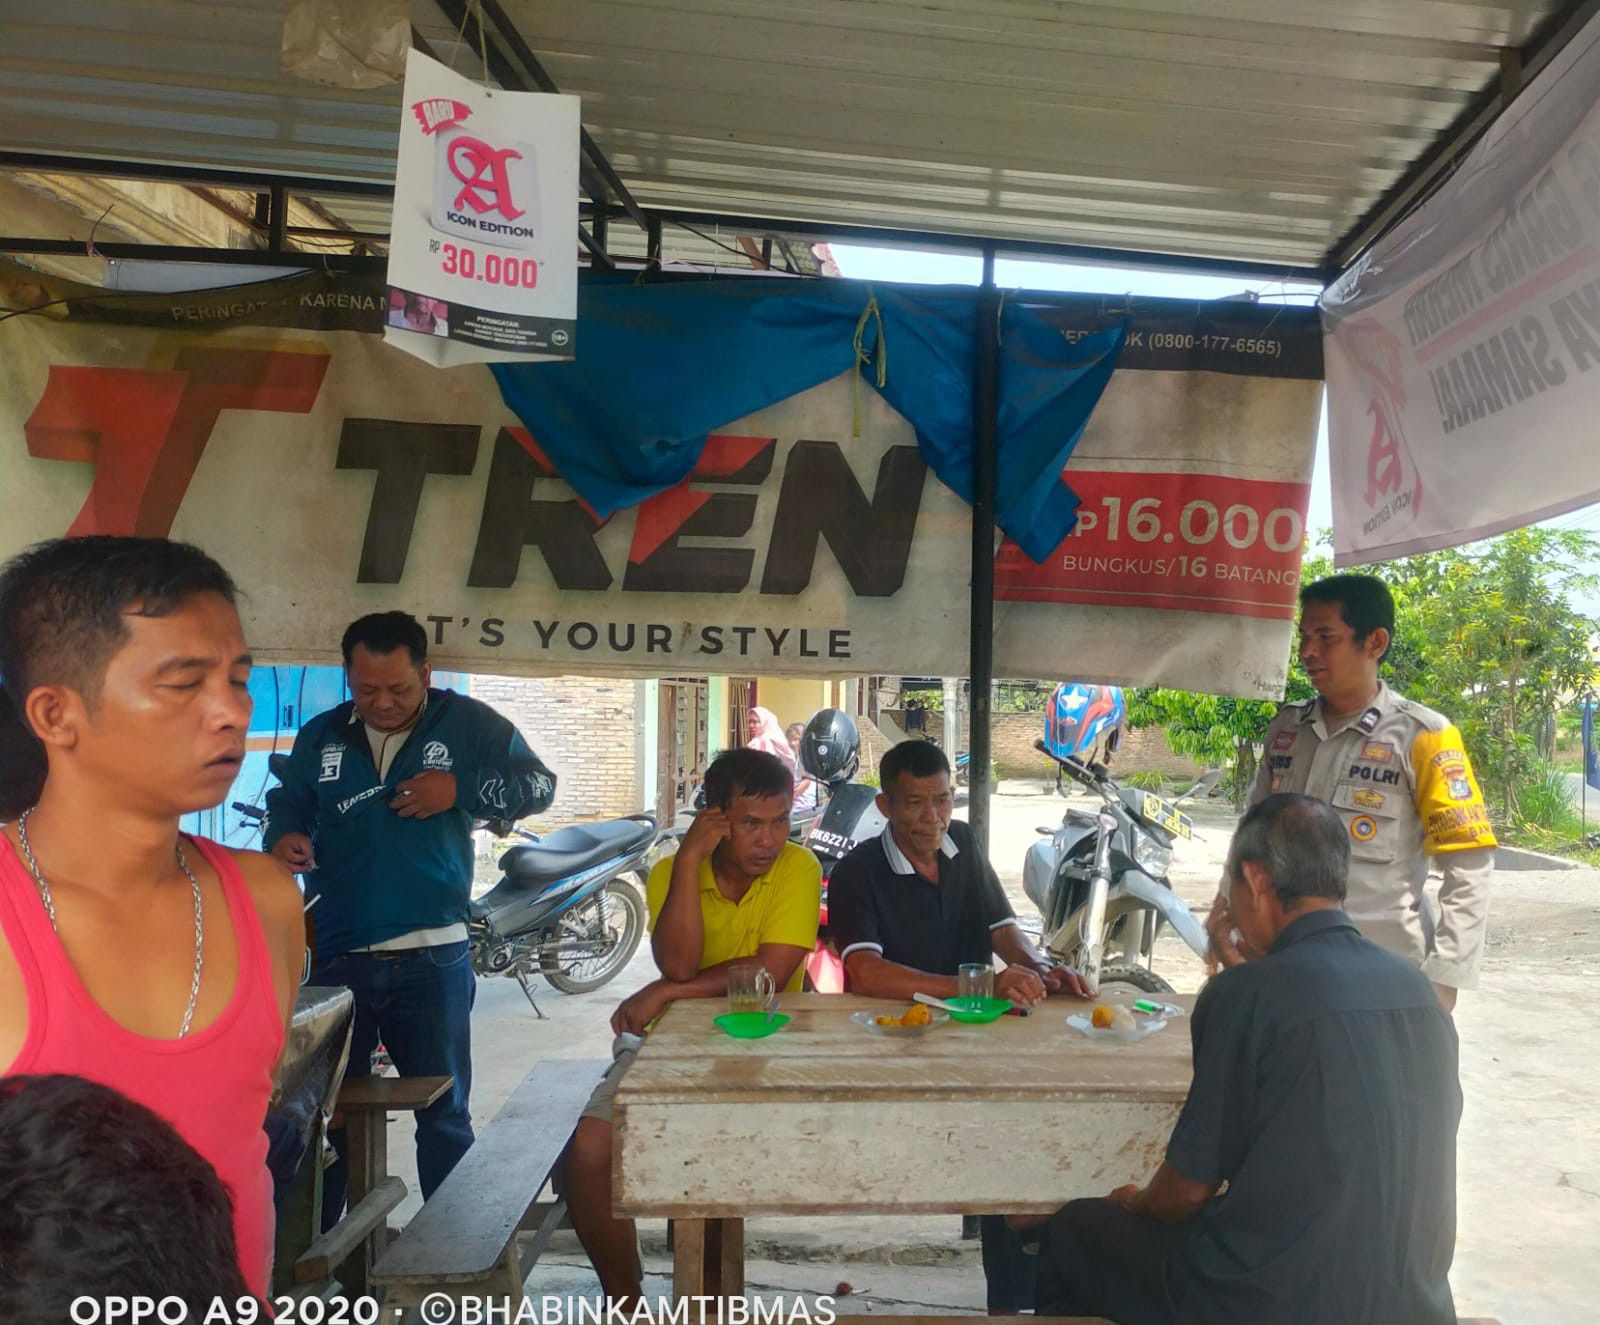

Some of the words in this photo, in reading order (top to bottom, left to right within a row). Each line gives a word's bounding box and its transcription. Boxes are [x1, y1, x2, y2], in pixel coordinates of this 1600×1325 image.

[422, 101, 455, 128] BARU
[447, 211, 477, 228] ICON
[479, 220, 534, 238] EDITION
[429, 239, 440, 253] RP
[301, 292, 374, 311] KARENA
[1148, 332, 1282, 356] (0800-177-6565)
[336, 418, 928, 597] TREN
[1215, 564, 1298, 587] BATANG
[427, 615, 505, 647] T'S
[533, 620, 672, 653] YOUR
[700, 627, 852, 658] STYLE
[1349, 765, 1400, 786] POLRI
